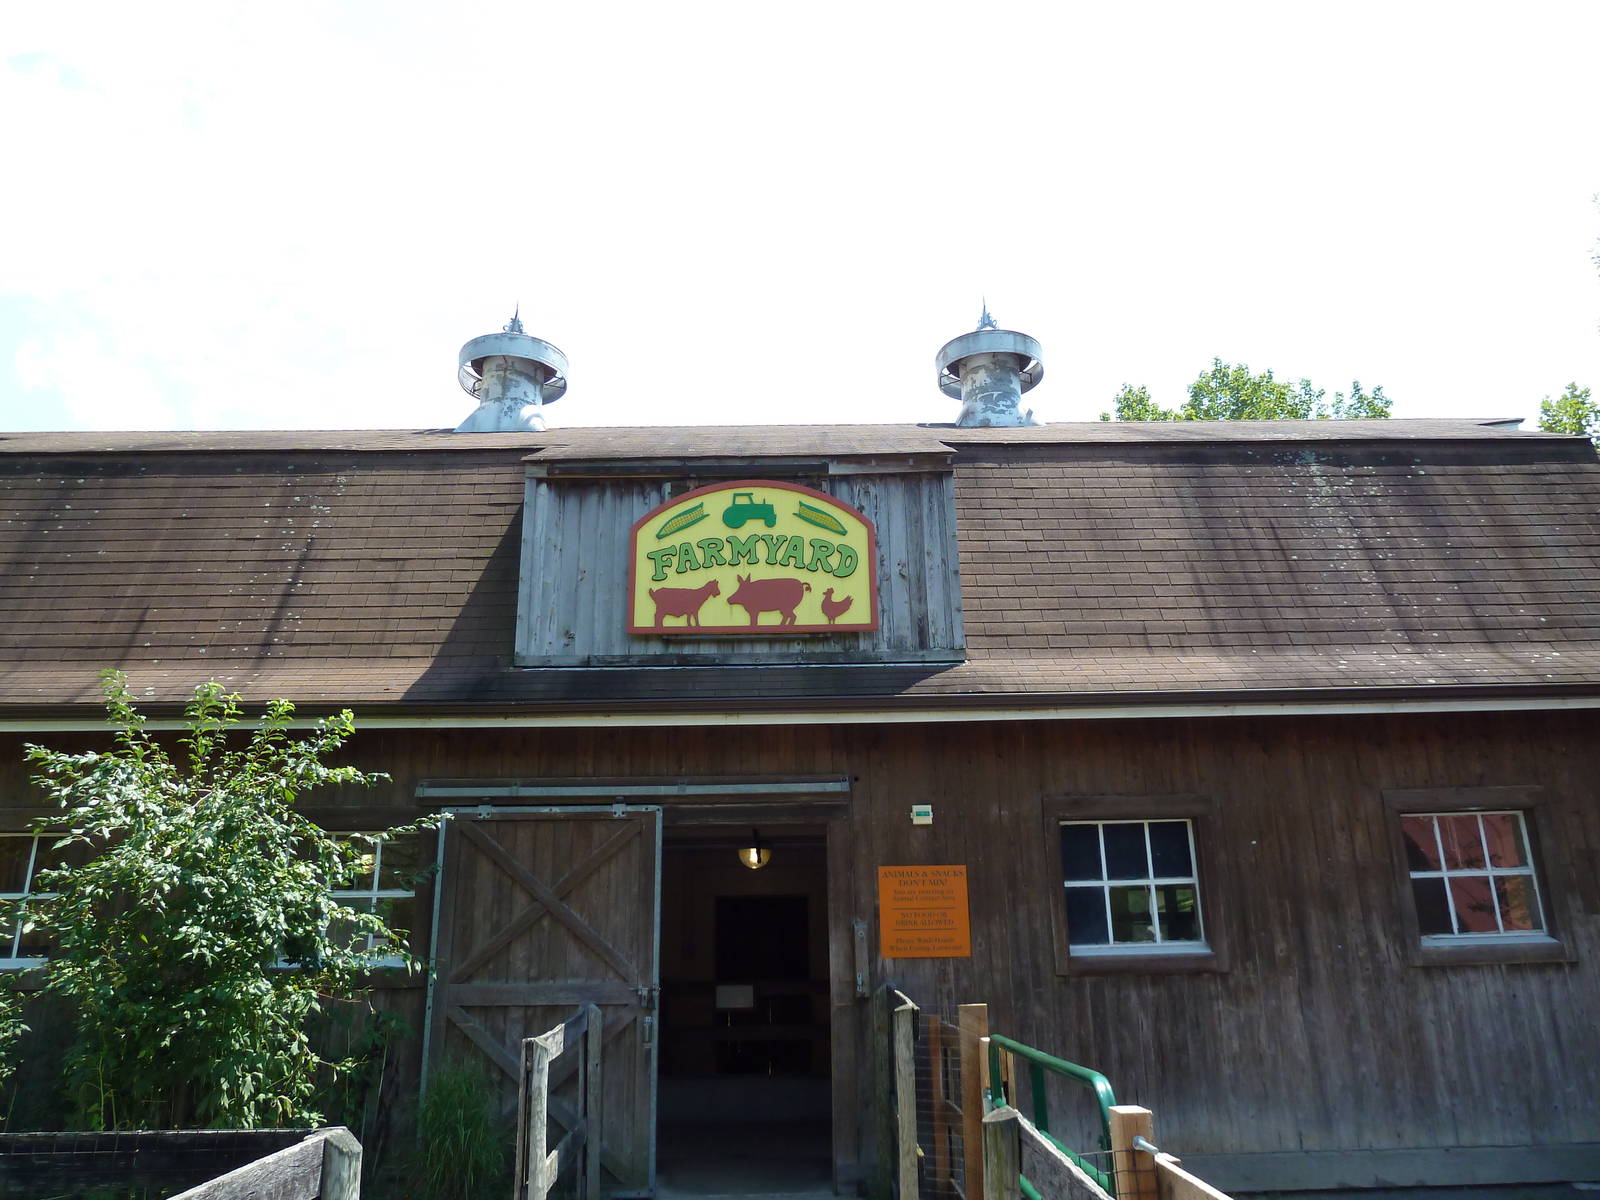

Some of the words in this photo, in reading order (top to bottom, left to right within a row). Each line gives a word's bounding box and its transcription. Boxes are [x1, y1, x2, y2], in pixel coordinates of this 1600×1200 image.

[647, 533, 859, 582] FARMYARD
[881, 870, 919, 879] ANIMALS
[931, 870, 964, 879] SNACKS
[898, 879, 924, 887] DON'T
